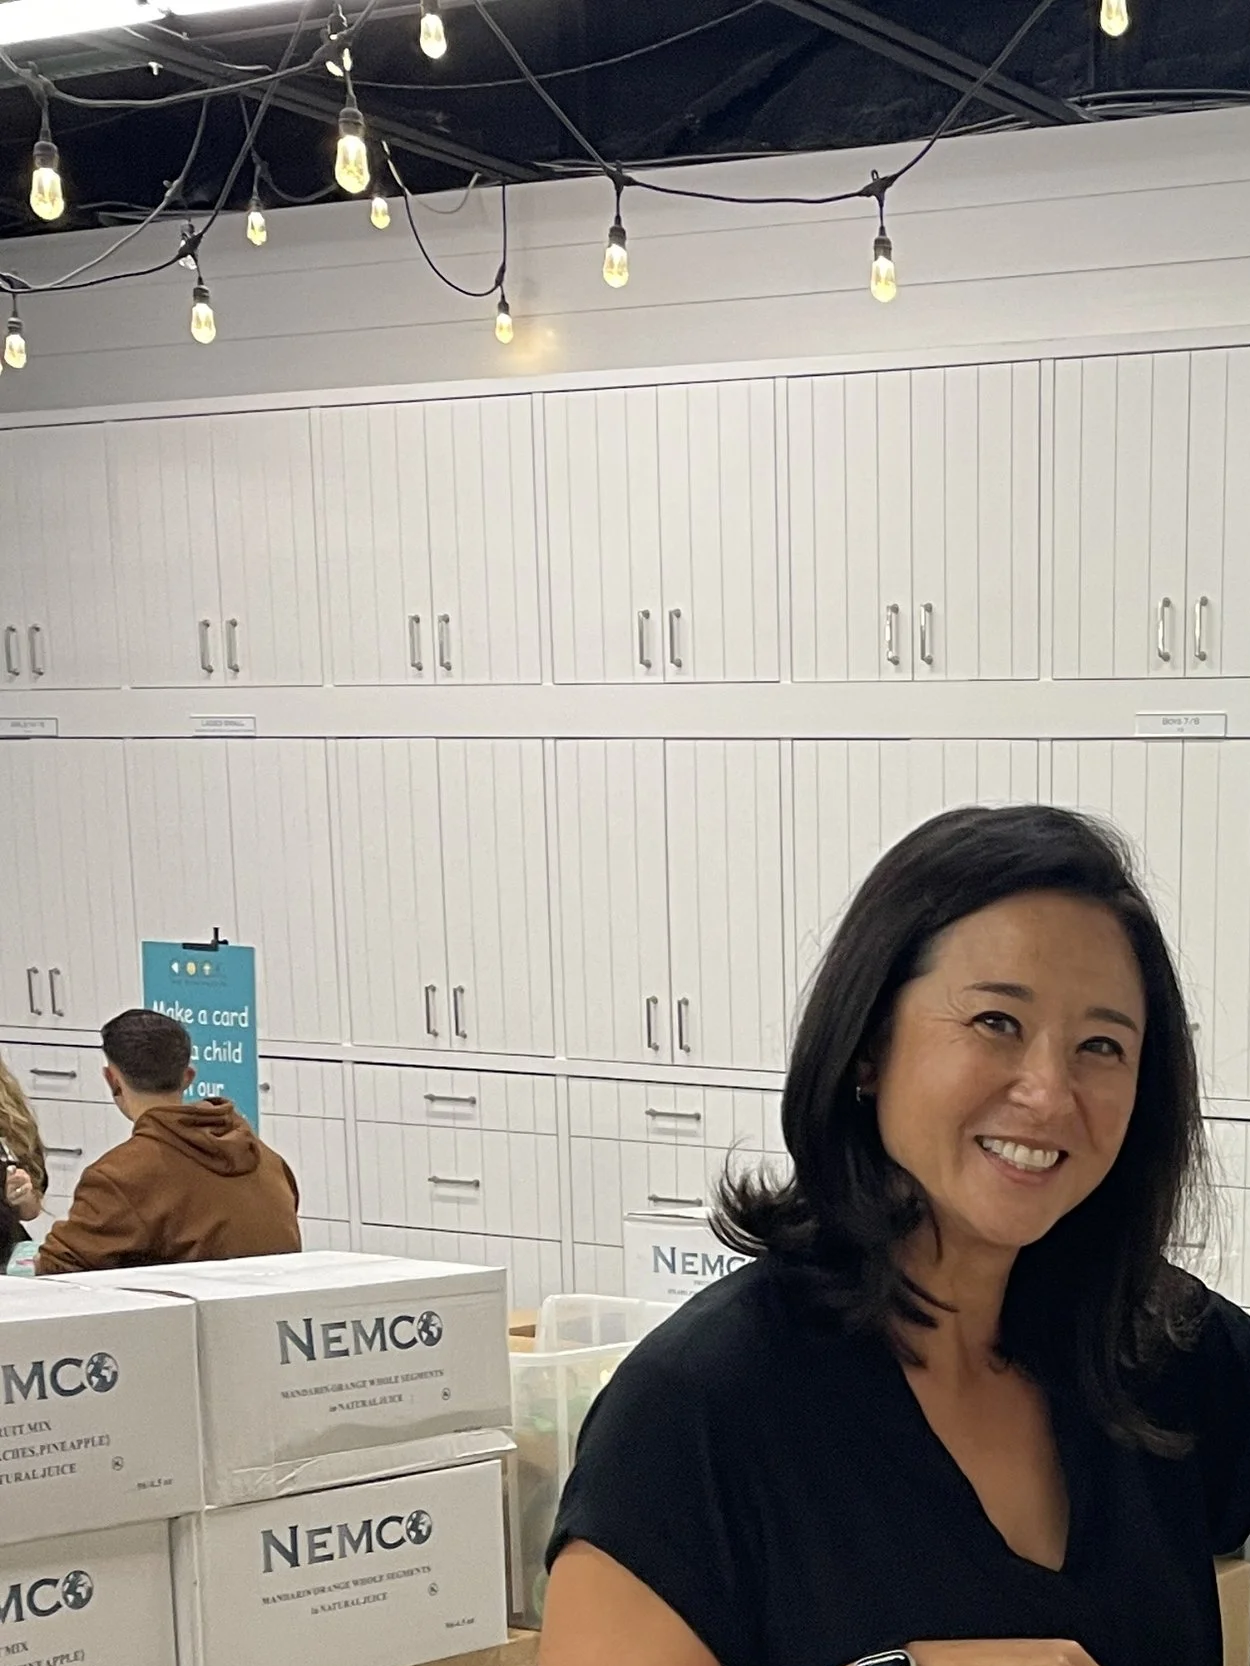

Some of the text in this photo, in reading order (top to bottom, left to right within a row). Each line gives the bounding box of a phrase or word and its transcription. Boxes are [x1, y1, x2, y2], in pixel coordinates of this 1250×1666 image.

[152, 1000, 249, 1028] Make a card
[203, 1040, 243, 1064] child
[197, 1082, 225, 1098] our
[652, 1245, 746, 1277] NEMC
[276, 1310, 444, 1366] NEMCO
[0, 1352, 120, 1405] MCO
[27, 1420, 53, 1434] MIX
[40, 1463, 77, 1479] JUICE
[260, 1509, 433, 1574] NEMCO
[0, 1569, 94, 1625] MCO
